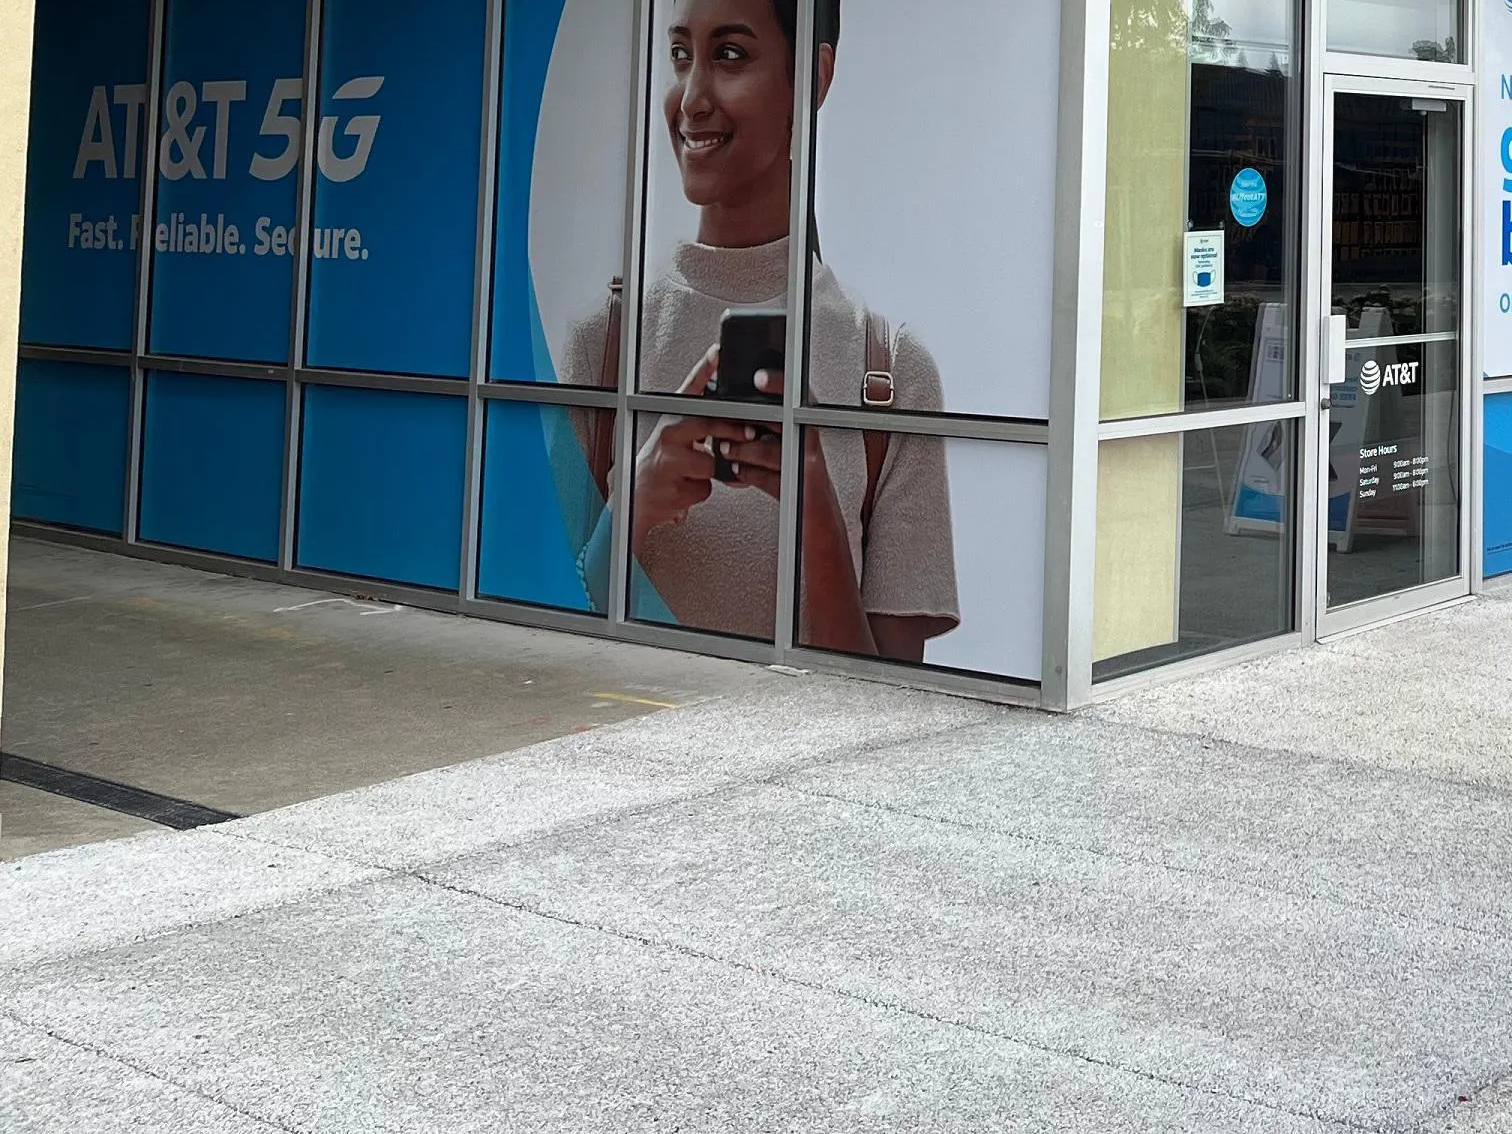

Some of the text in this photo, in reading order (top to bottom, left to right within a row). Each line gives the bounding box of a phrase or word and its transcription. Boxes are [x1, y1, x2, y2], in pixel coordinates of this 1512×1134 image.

[72, 76, 385, 182] AT&T 5G
[68, 213, 123, 250] Fast.
[1382, 361, 1419, 387] AT&T
[1359, 445, 1397, 458] Store Hours
[1360, 489, 1376, 498] Sunday
